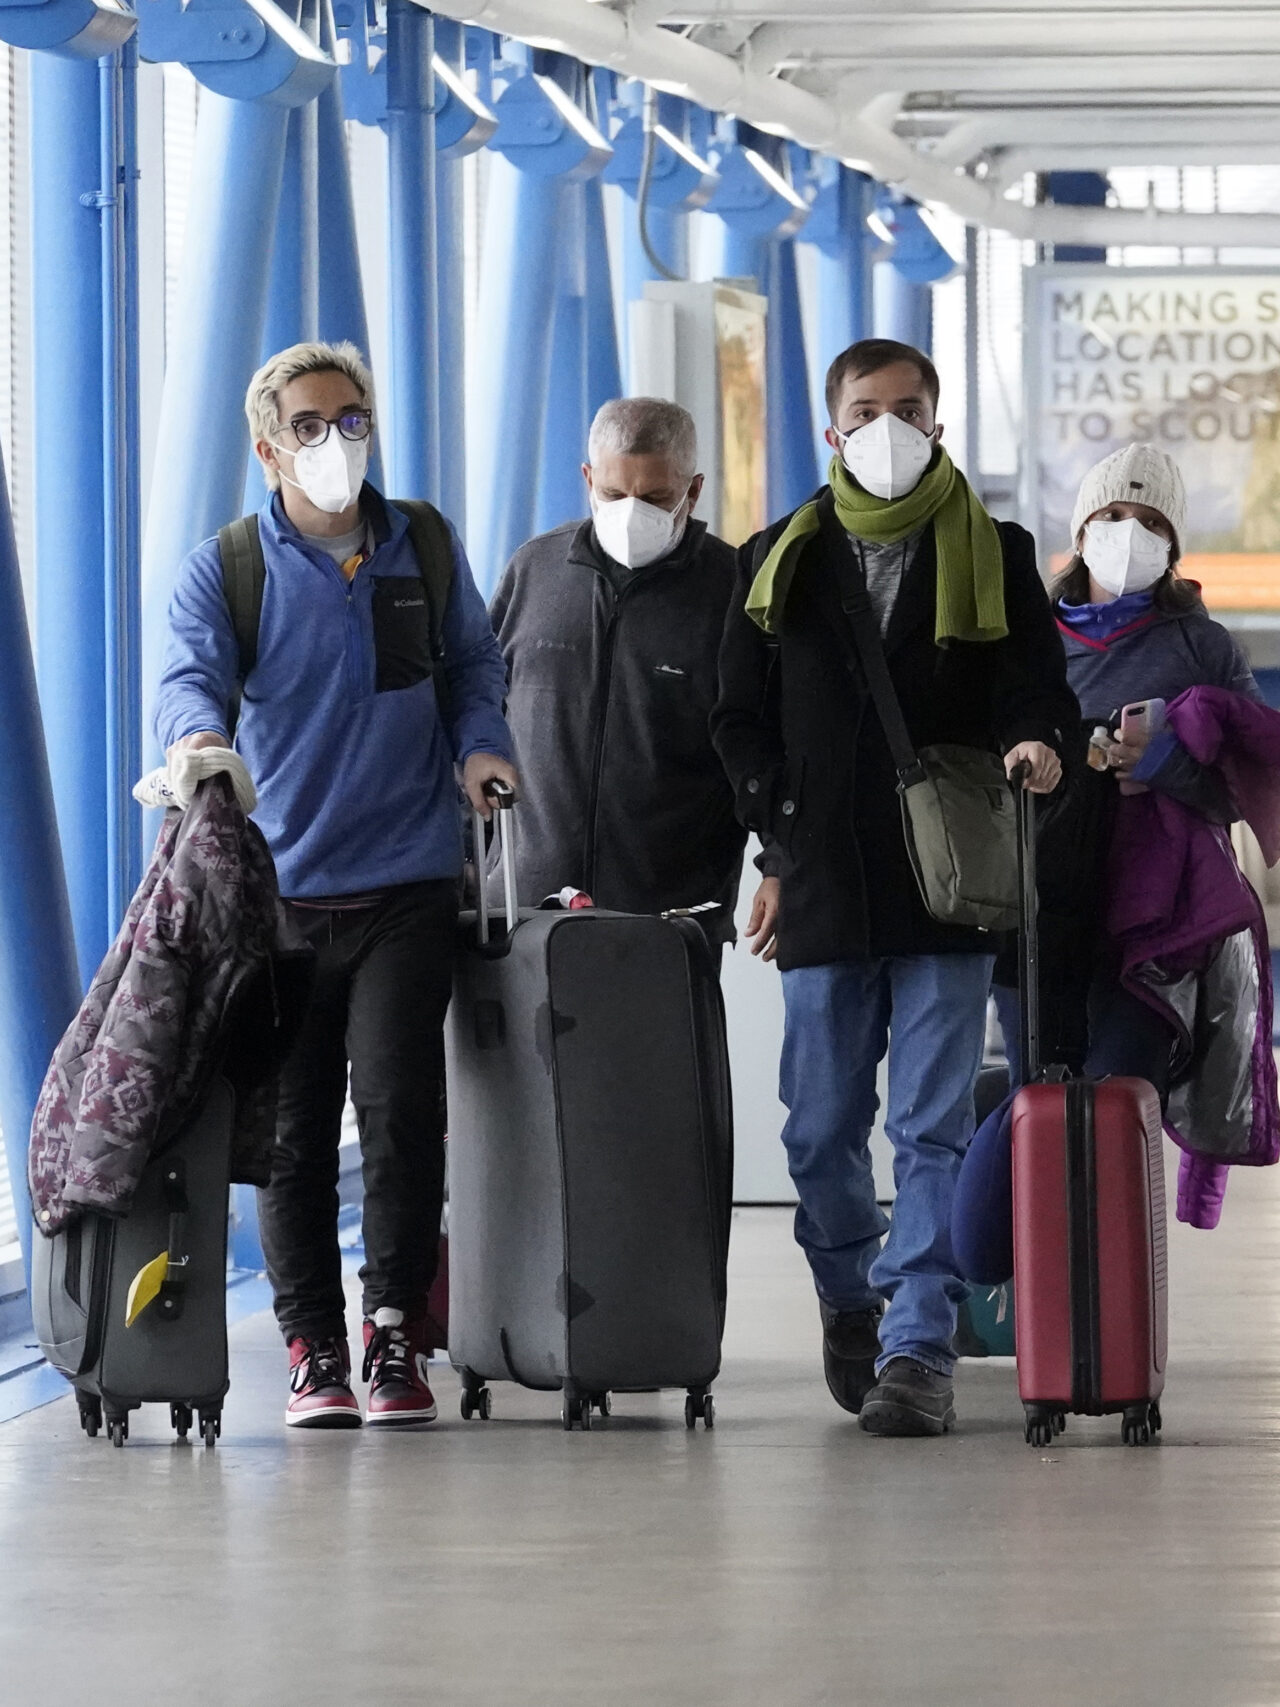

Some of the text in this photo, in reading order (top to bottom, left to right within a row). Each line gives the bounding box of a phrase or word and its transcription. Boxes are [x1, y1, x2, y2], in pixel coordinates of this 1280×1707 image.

[1051, 290, 1240, 324] MAKING
[1051, 370, 1144, 404] HAS
[1051, 410, 1113, 443] TO
